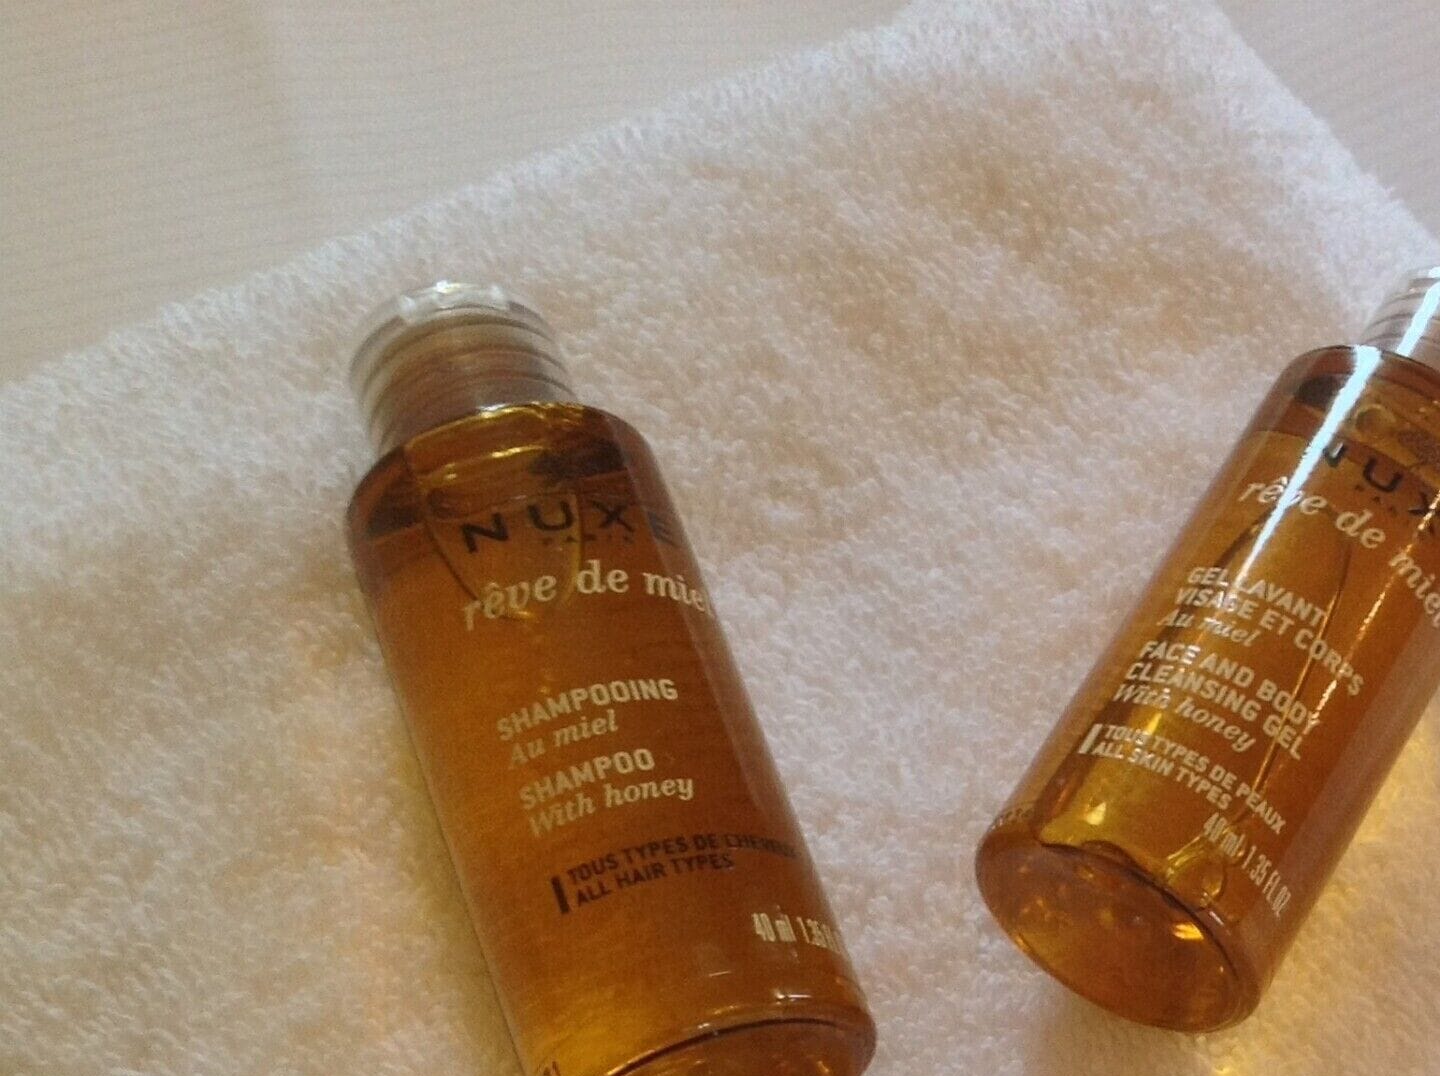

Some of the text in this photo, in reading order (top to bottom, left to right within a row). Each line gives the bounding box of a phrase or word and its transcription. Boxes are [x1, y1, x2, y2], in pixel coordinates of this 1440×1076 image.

[1335, 508, 1386, 549] de
[463, 573, 557, 632] rêve
[576, 559, 629, 594] de
[1156, 608, 1195, 629] Au
[1187, 566, 1328, 628] GEL LAVANT
[1174, 587, 1365, 697] VISAGE ET CORPS
[497, 678, 678, 741] SHAMPOOING
[1113, 684, 1257, 754] With honey
[1124, 662, 1304, 760] CLEANSING GEL
[1139, 640, 1321, 736] FACE AND BODY
[510, 709, 619, 769] Au miel
[519, 748, 655, 810] SHAMPOO
[528, 776, 694, 838] With honey
[1091, 742, 1233, 810] ALL SKIN TYPES
[1104, 724, 1286, 835] TOUS TYPES DE PEAUX
[567, 851, 618, 884] TOUS
[624, 835, 688, 864] TYPES
[693, 833, 720, 851] DE
[574, 852, 735, 907] ALL HAIR TYPES
